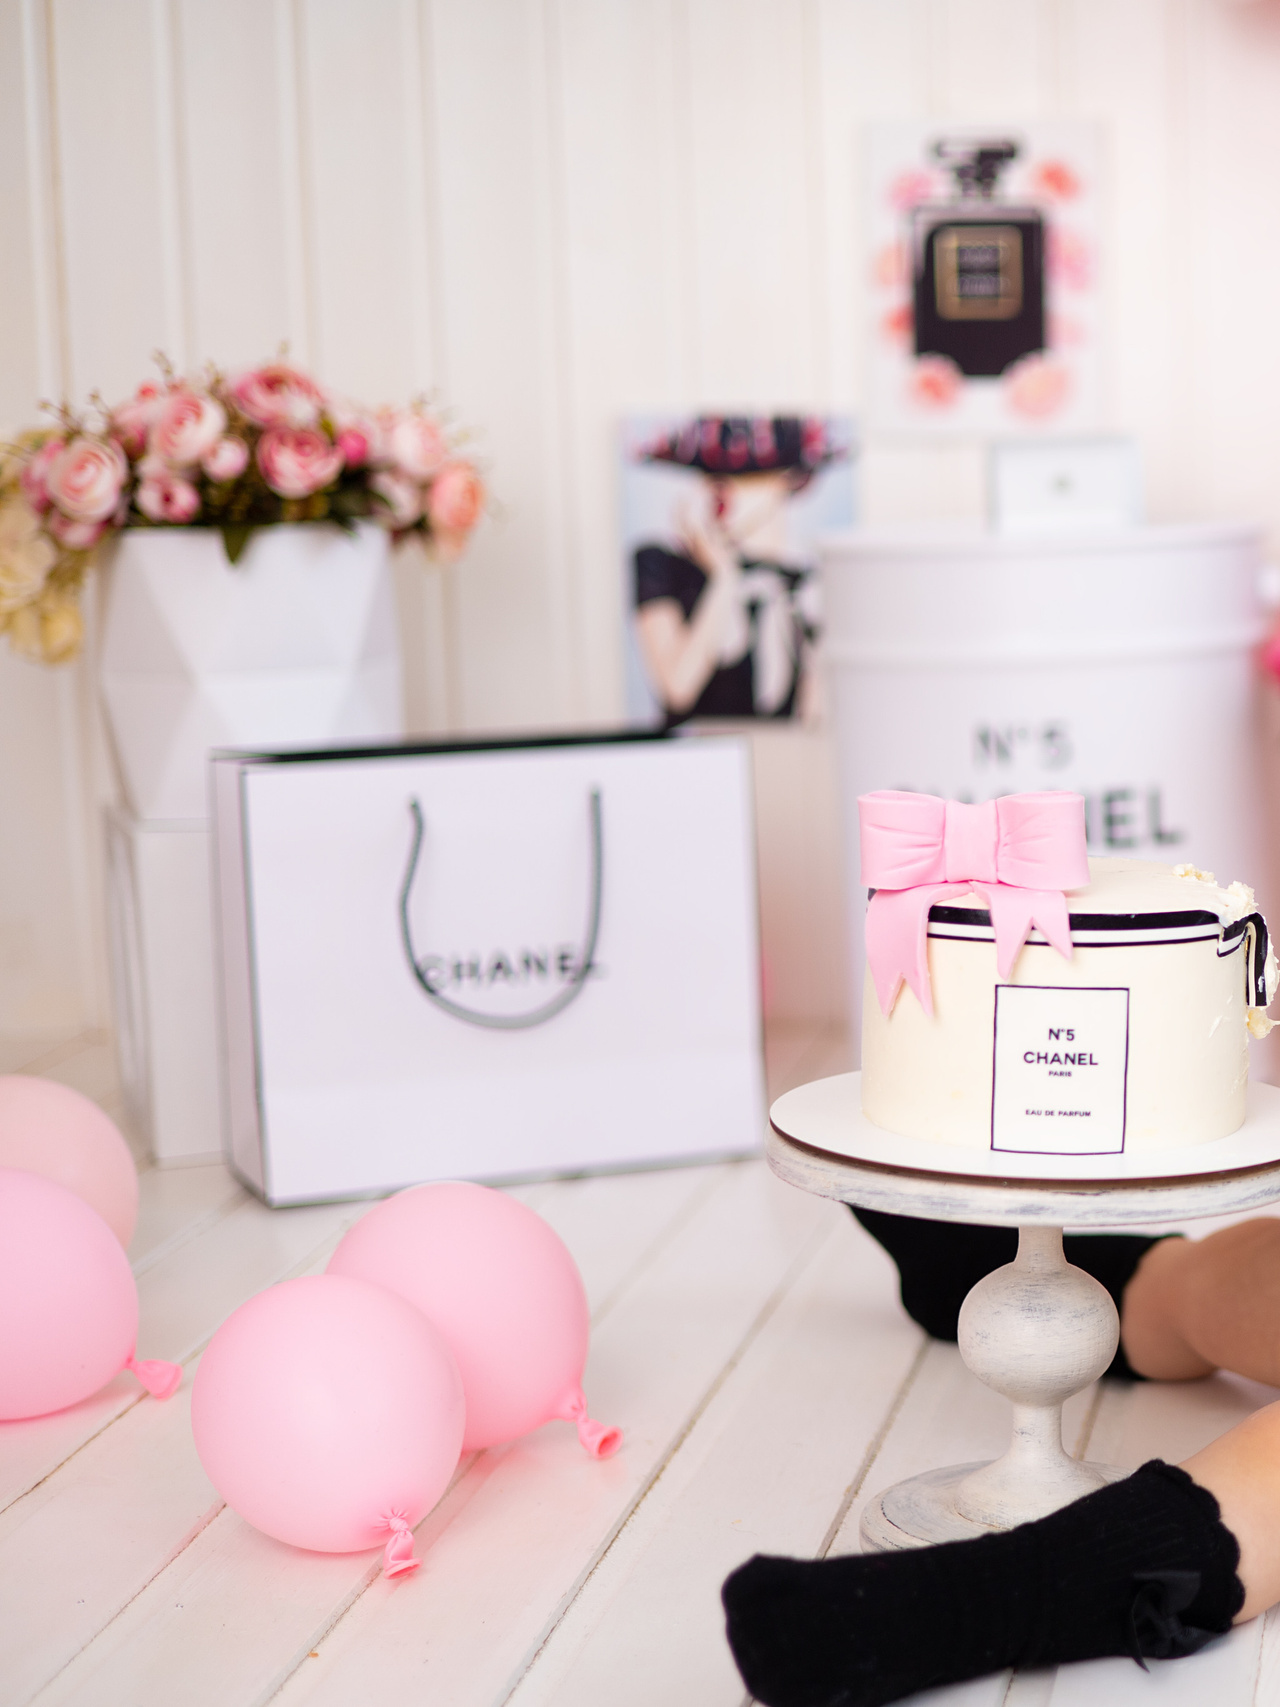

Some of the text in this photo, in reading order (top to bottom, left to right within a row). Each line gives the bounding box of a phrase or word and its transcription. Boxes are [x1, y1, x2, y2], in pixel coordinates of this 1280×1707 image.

[1023, 1051, 1099, 1066] CHANEL
[1048, 1070, 1073, 1078] PARIS
[1025, 1109, 1042, 1117] EAU
[1057, 1110, 1092, 1118] PARFUM
